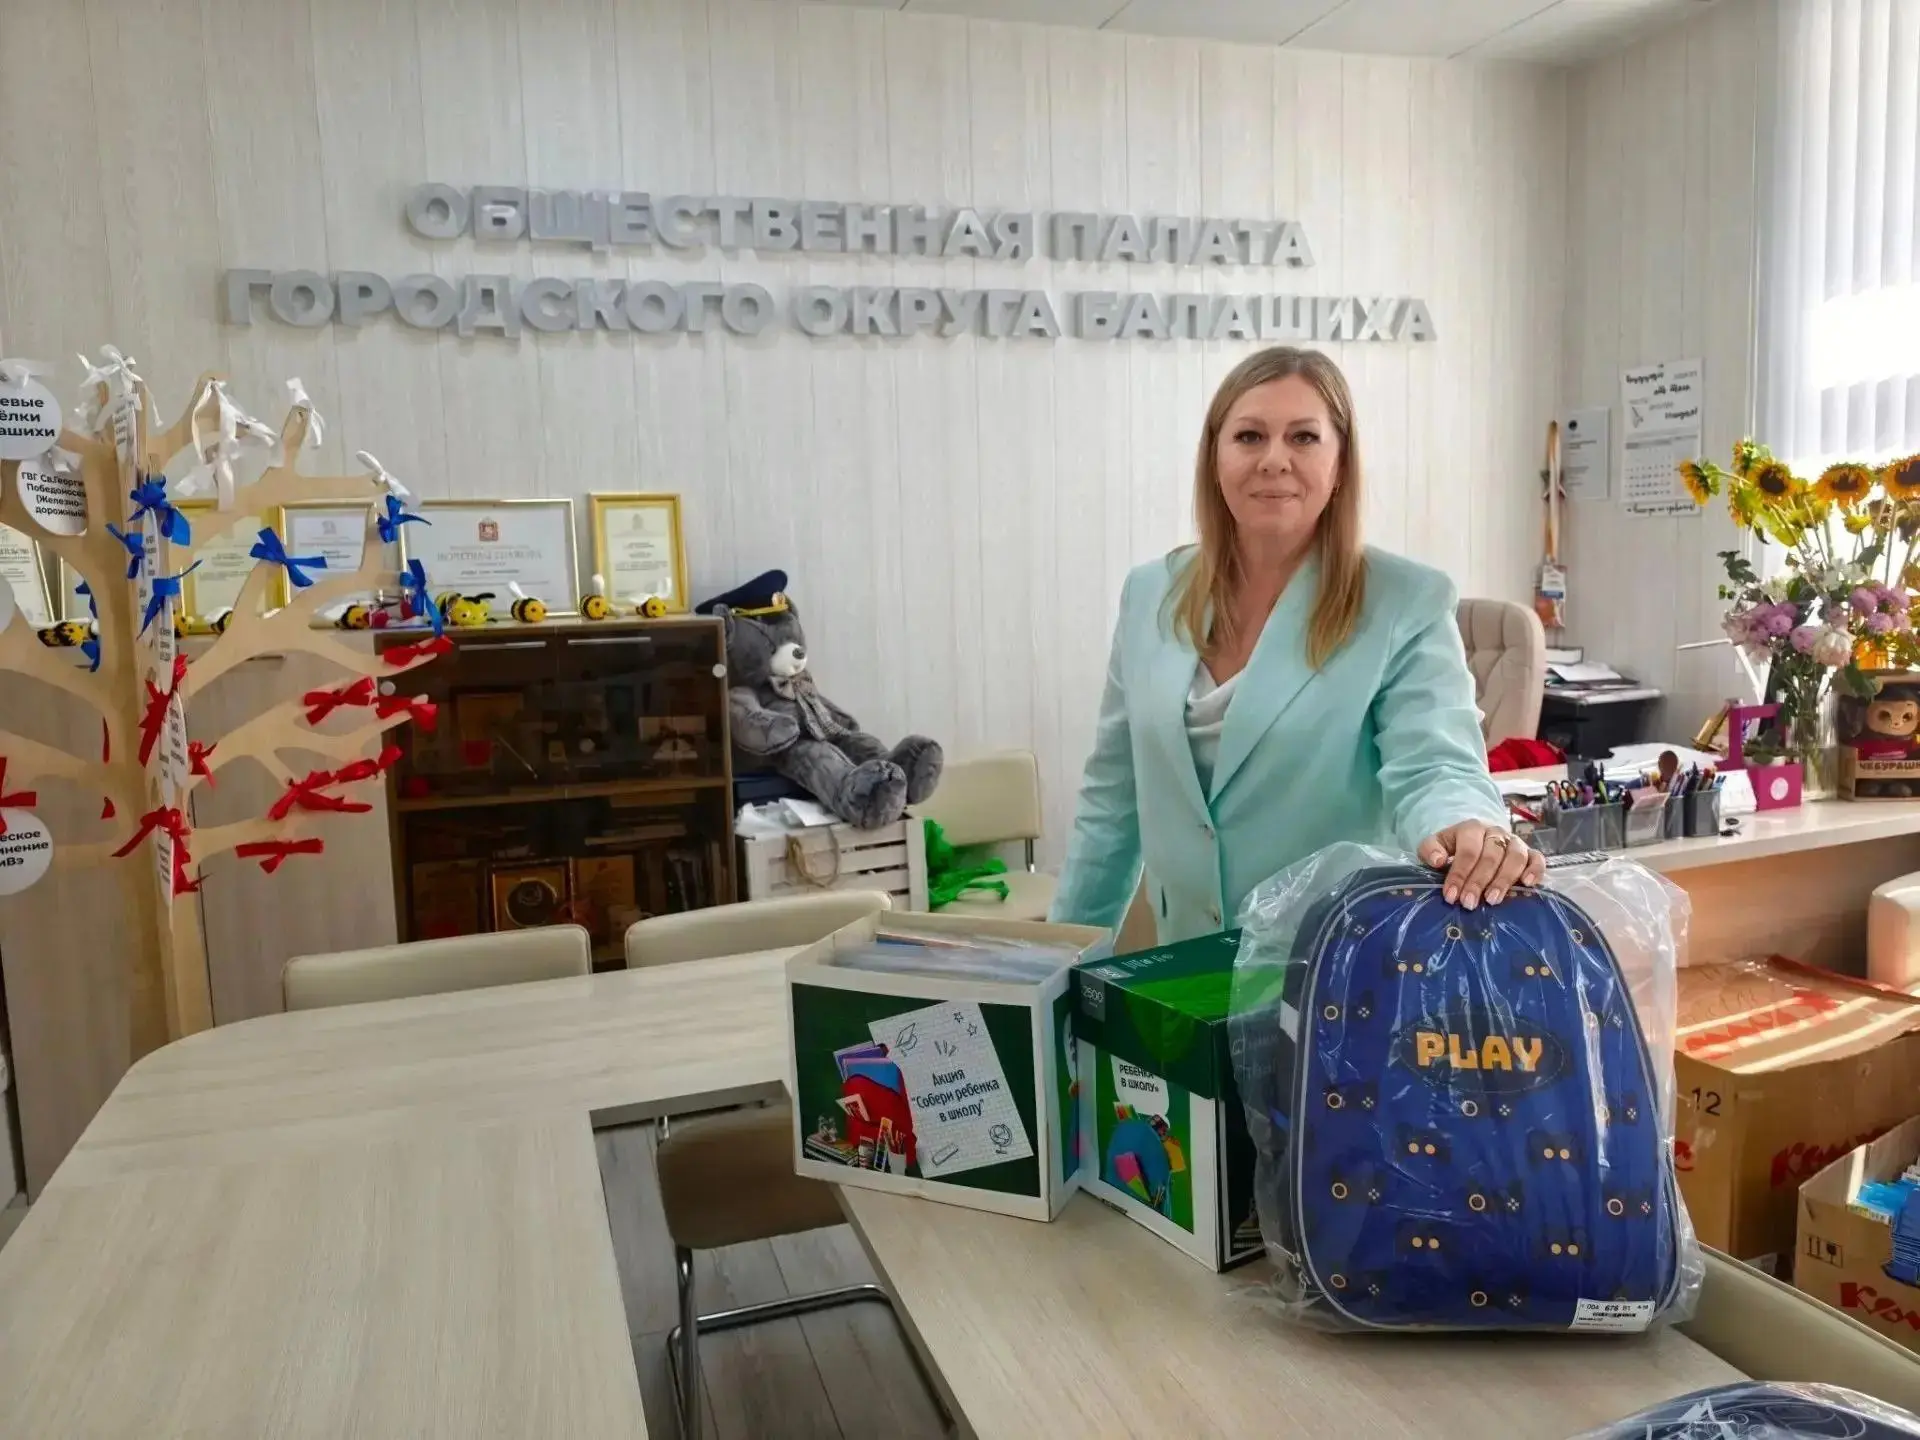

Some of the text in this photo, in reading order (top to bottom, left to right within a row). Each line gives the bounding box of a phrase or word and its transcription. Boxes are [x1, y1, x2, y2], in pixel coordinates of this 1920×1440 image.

[405, 182, 1315, 267] ОБЩЕСТВЕННАЯ ПАЛАТА
[226, 268, 1438, 341] ГОРОДСКОГО ОКРУГА БАЛАШИХА
[0, 397, 45, 408] евые
[0, 409, 41, 422] ёлки
[0, 427, 55, 437] ашихи
[0, 831, 41, 842] еское
[0, 842, 49, 855] нение
[1416, 1031, 1542, 1072] PLAY
[932, 1069, 966, 1087] Акция
[911, 1079, 1000, 1109] "Собери ребенка
[1691, 1087, 1721, 1117] 12
[939, 1098, 984, 1122] в школу"
